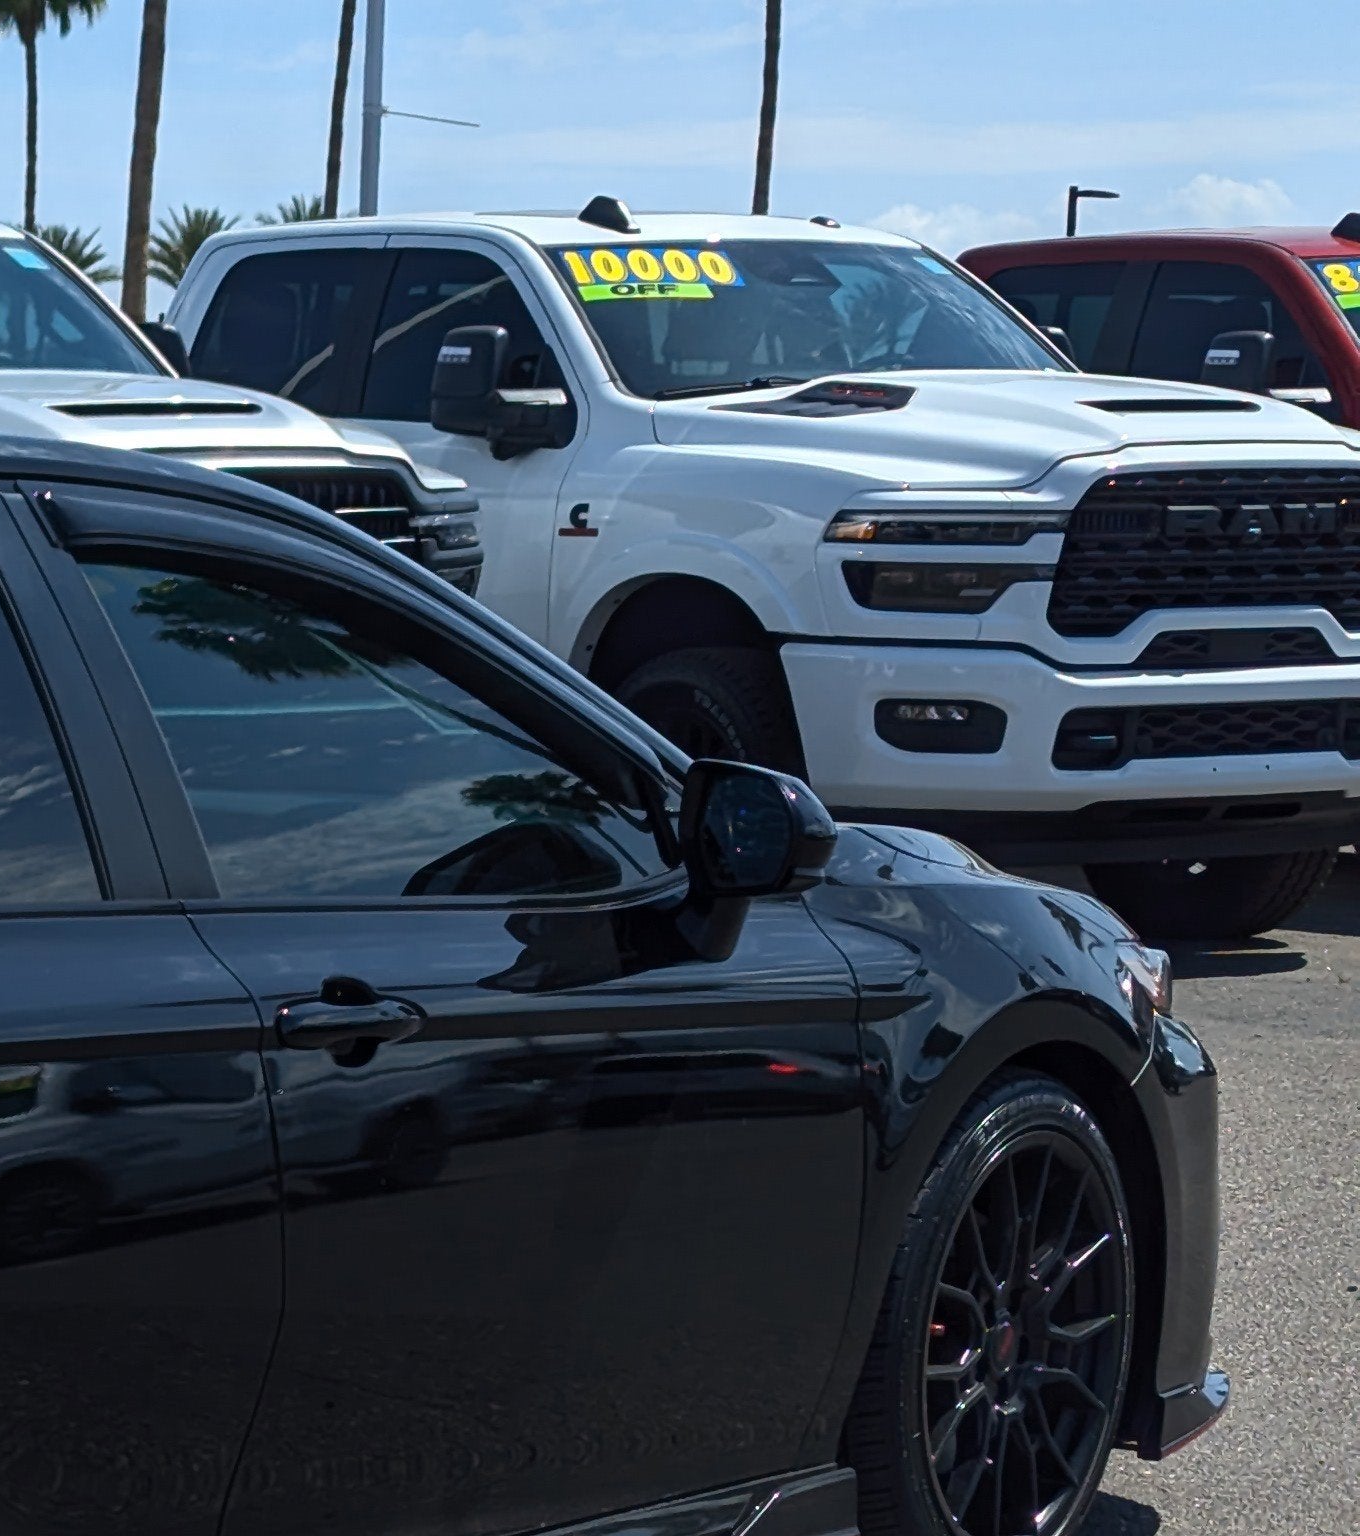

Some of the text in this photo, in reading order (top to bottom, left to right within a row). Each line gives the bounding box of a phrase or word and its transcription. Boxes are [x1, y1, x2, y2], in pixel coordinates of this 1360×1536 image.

[564, 249, 737, 285] 10000
[1322, 263, 1360, 293] 8
[610, 283, 680, 296] OFF
[1166, 502, 1337, 535] RAM
